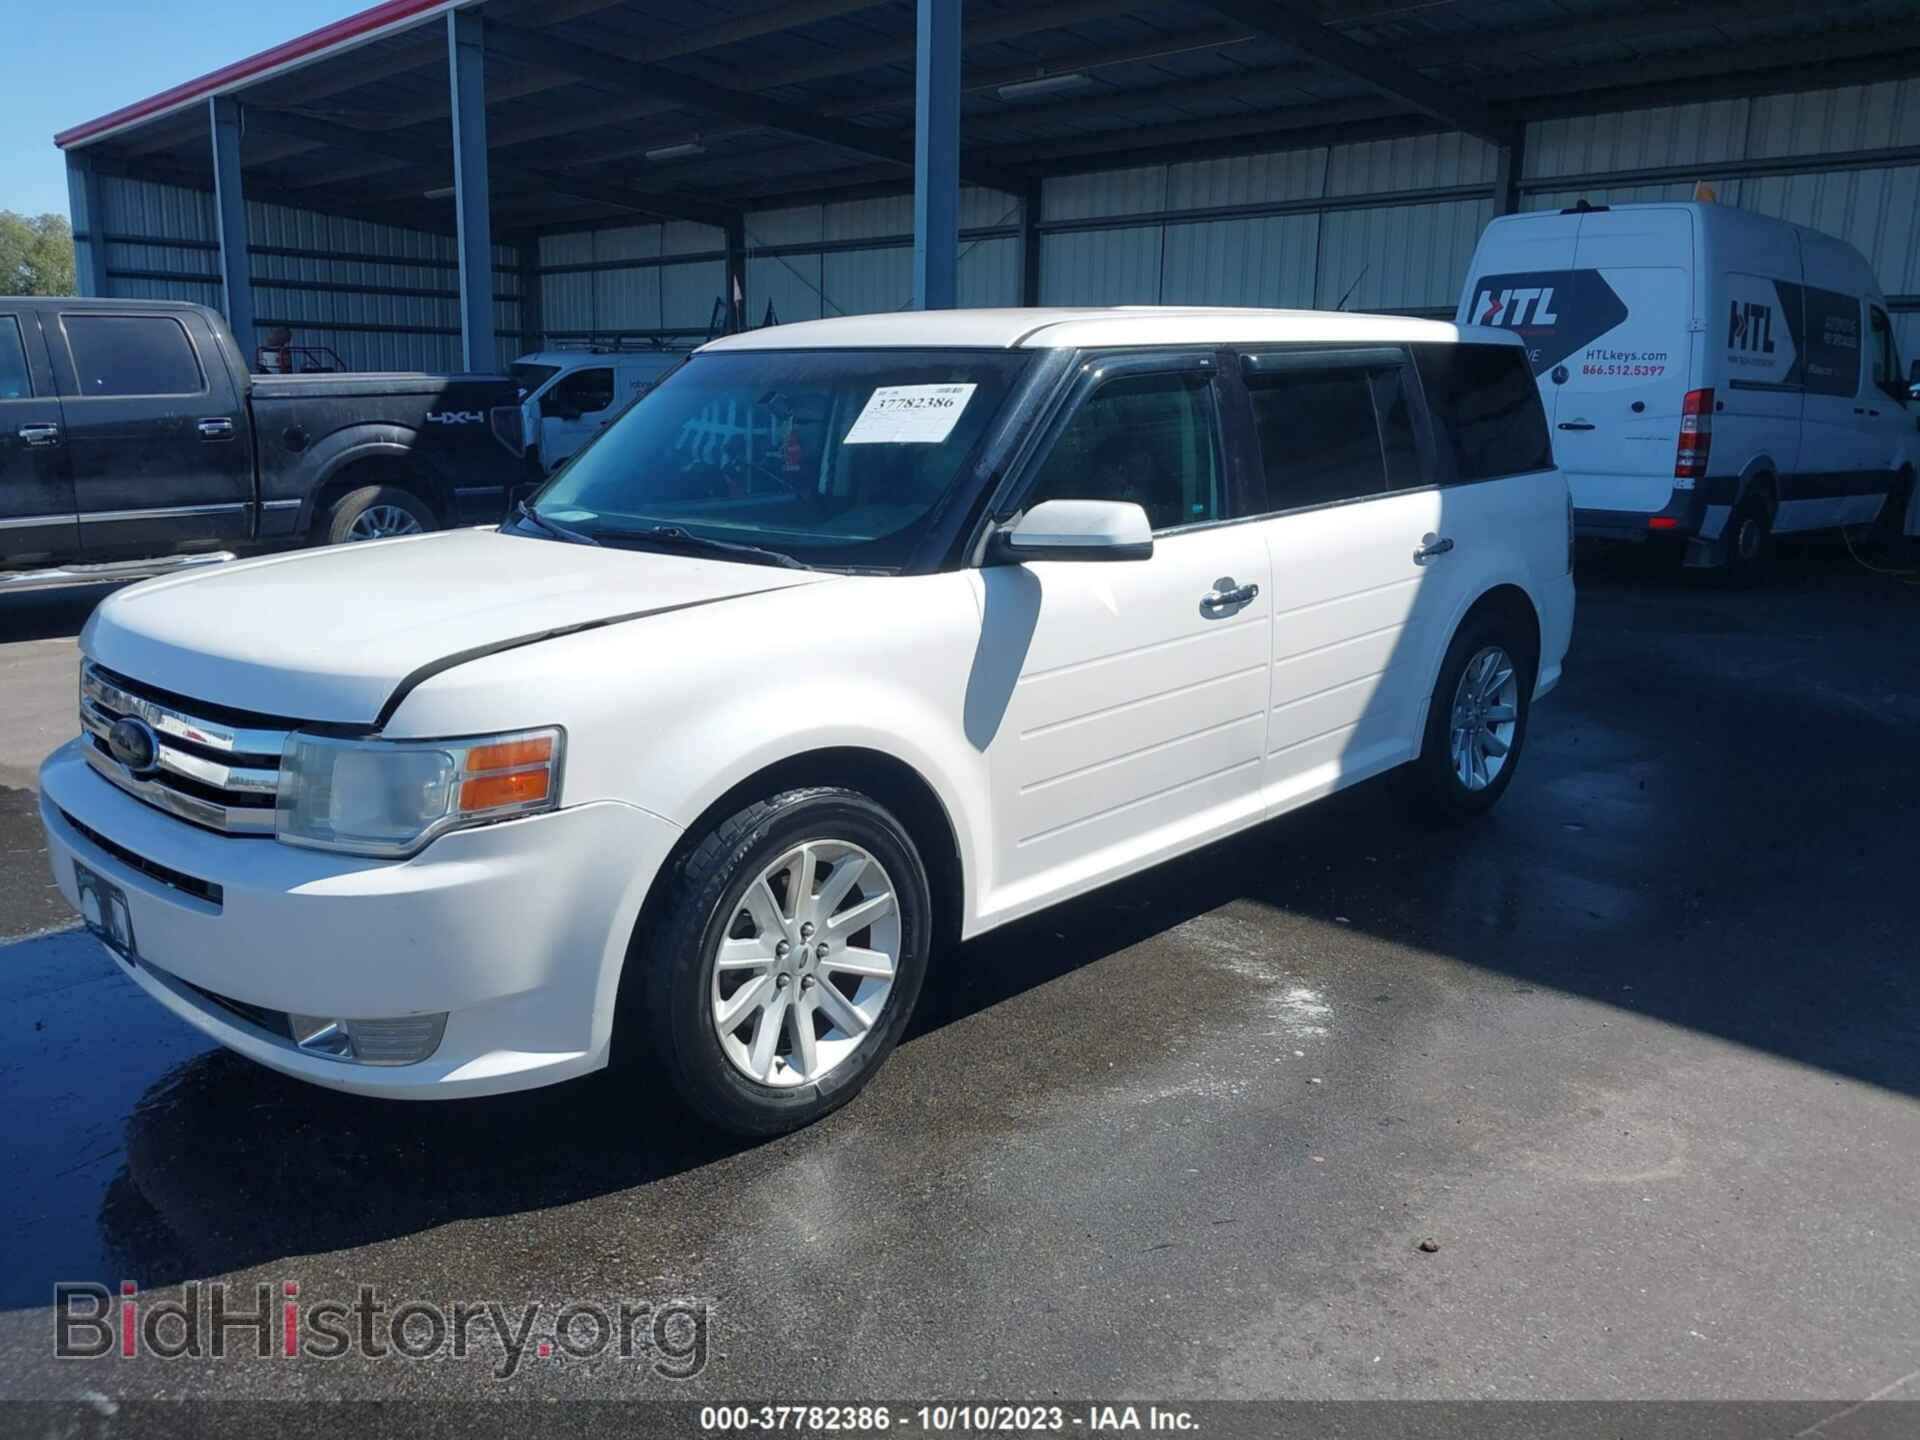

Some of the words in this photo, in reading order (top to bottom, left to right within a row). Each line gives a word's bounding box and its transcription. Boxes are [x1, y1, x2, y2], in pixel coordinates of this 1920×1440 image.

[1472, 287, 1558, 326] HTL
[1728, 300, 1775, 353] HTL
[1586, 349, 1667, 363] HTLkeys.com
[1582, 364, 1665, 377] 866.512.5397
[878, 396, 955, 410] 37782386
